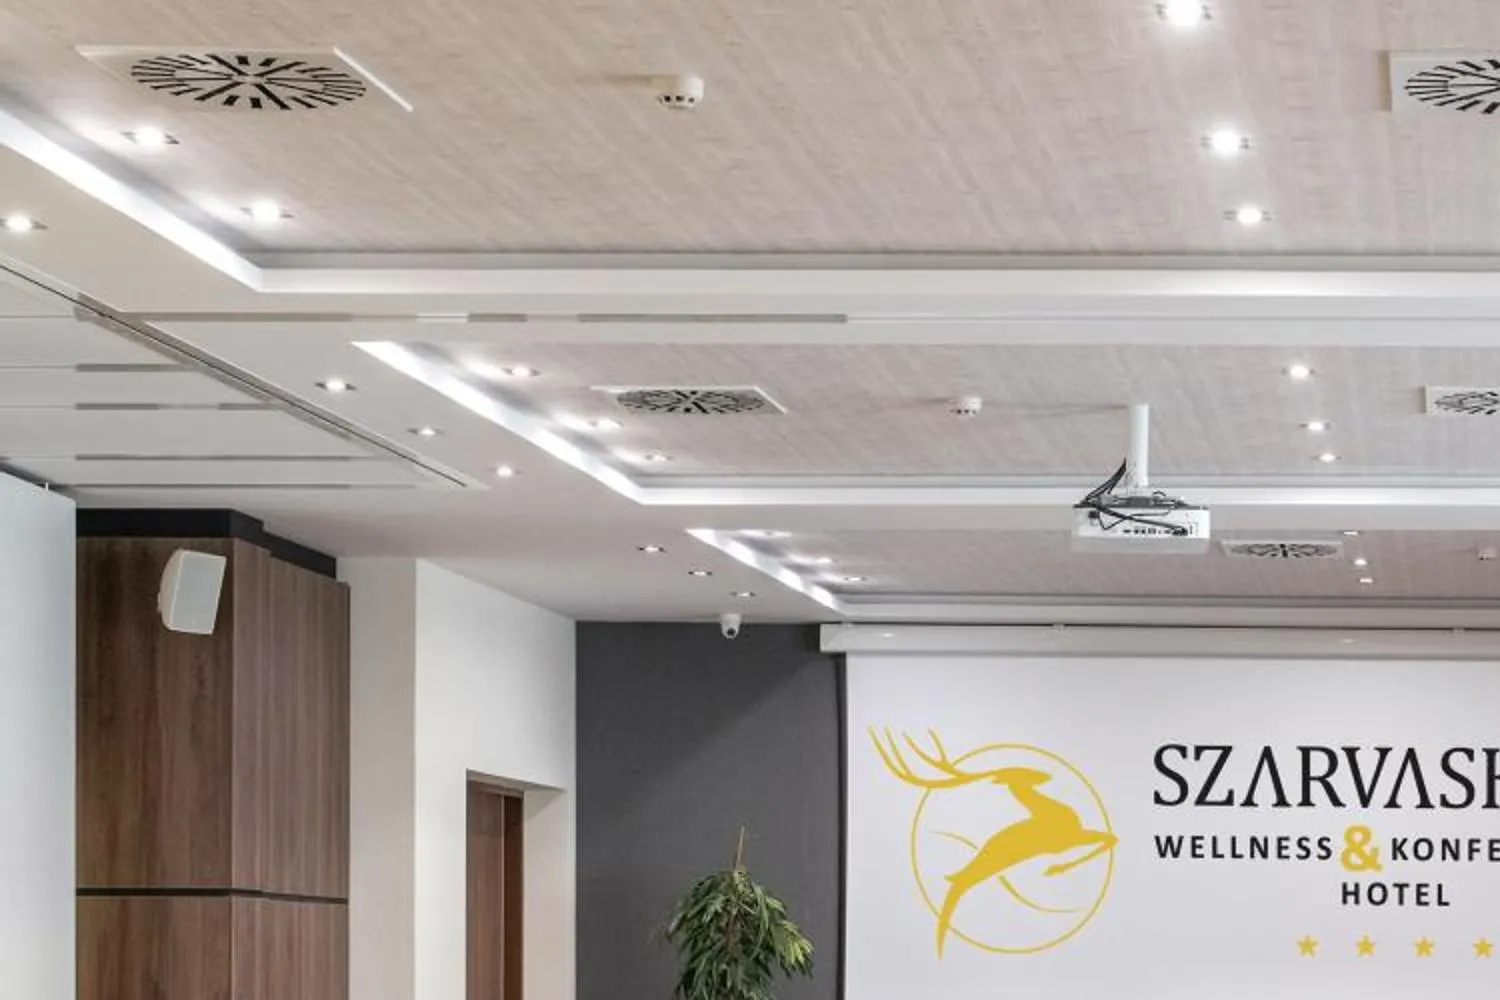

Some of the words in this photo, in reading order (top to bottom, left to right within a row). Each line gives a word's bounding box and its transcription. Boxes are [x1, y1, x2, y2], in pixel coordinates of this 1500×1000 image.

[1154, 835, 1332, 861] WELLNESS
[1339, 824, 1383, 873] &
[1341, 882, 1450, 907] HOTEL
